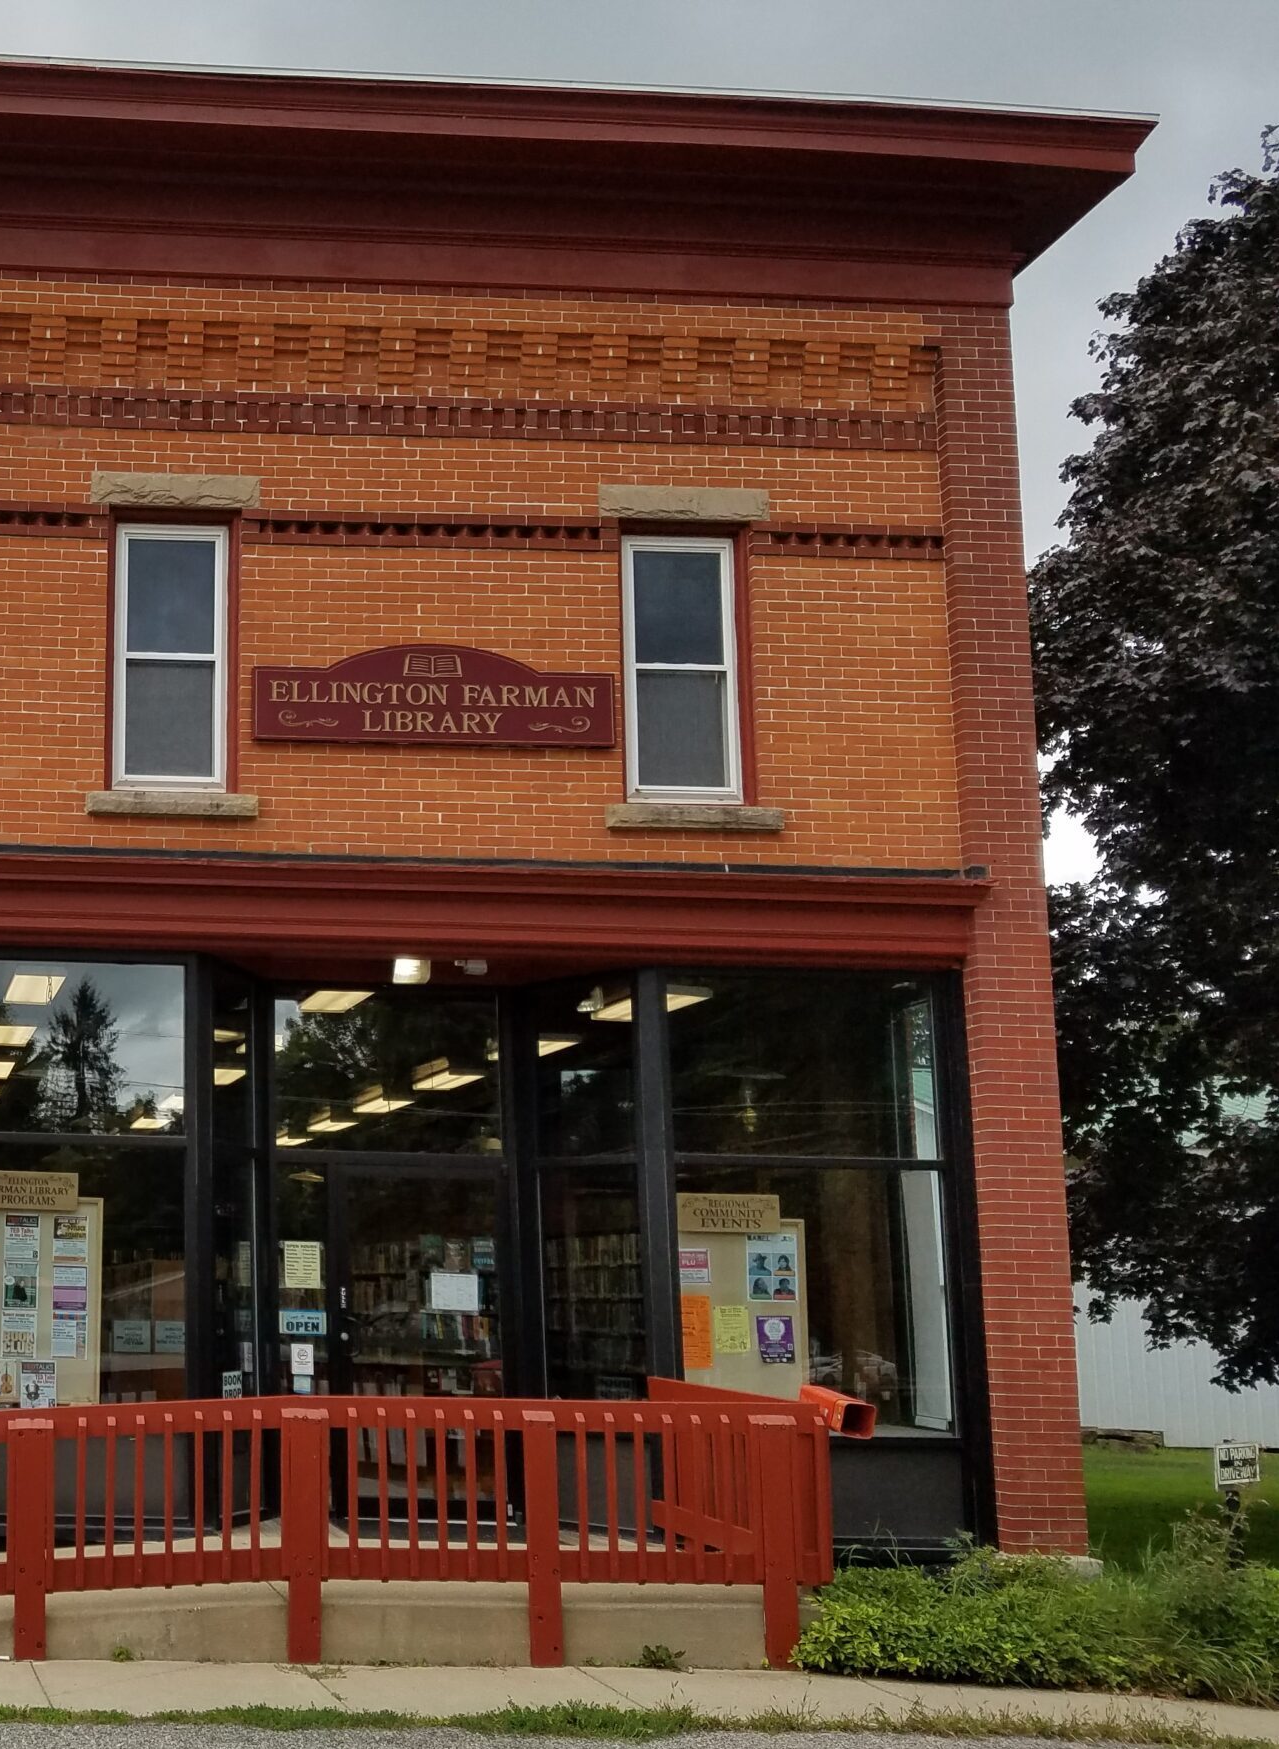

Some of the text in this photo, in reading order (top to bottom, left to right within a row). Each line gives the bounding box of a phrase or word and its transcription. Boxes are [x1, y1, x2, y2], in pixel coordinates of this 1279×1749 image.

[269, 679, 598, 709] ELLINGTON FARMAN
[362, 710, 503, 735] LIBRARY
[8, 1177, 49, 1186] ELLINGTON
[29, 1186, 70, 1196] LIBRARY
[1, 1195, 56, 1206] PROGRAMS
[708, 1200, 750, 1209] REGIONAL
[693, 1208, 765, 1219] COMMUNITY
[700, 1218, 762, 1229] EVENTS
[286, 1321, 320, 1332] OPEN
[2, 1331, 34, 1343] BOOK
[2, 1341, 34, 1354] CLUB
[223, 1374, 242, 1386] BOOK
[224, 1388, 242, 1399] DROP
[1219, 1447, 1256, 1461] NO PARKING
